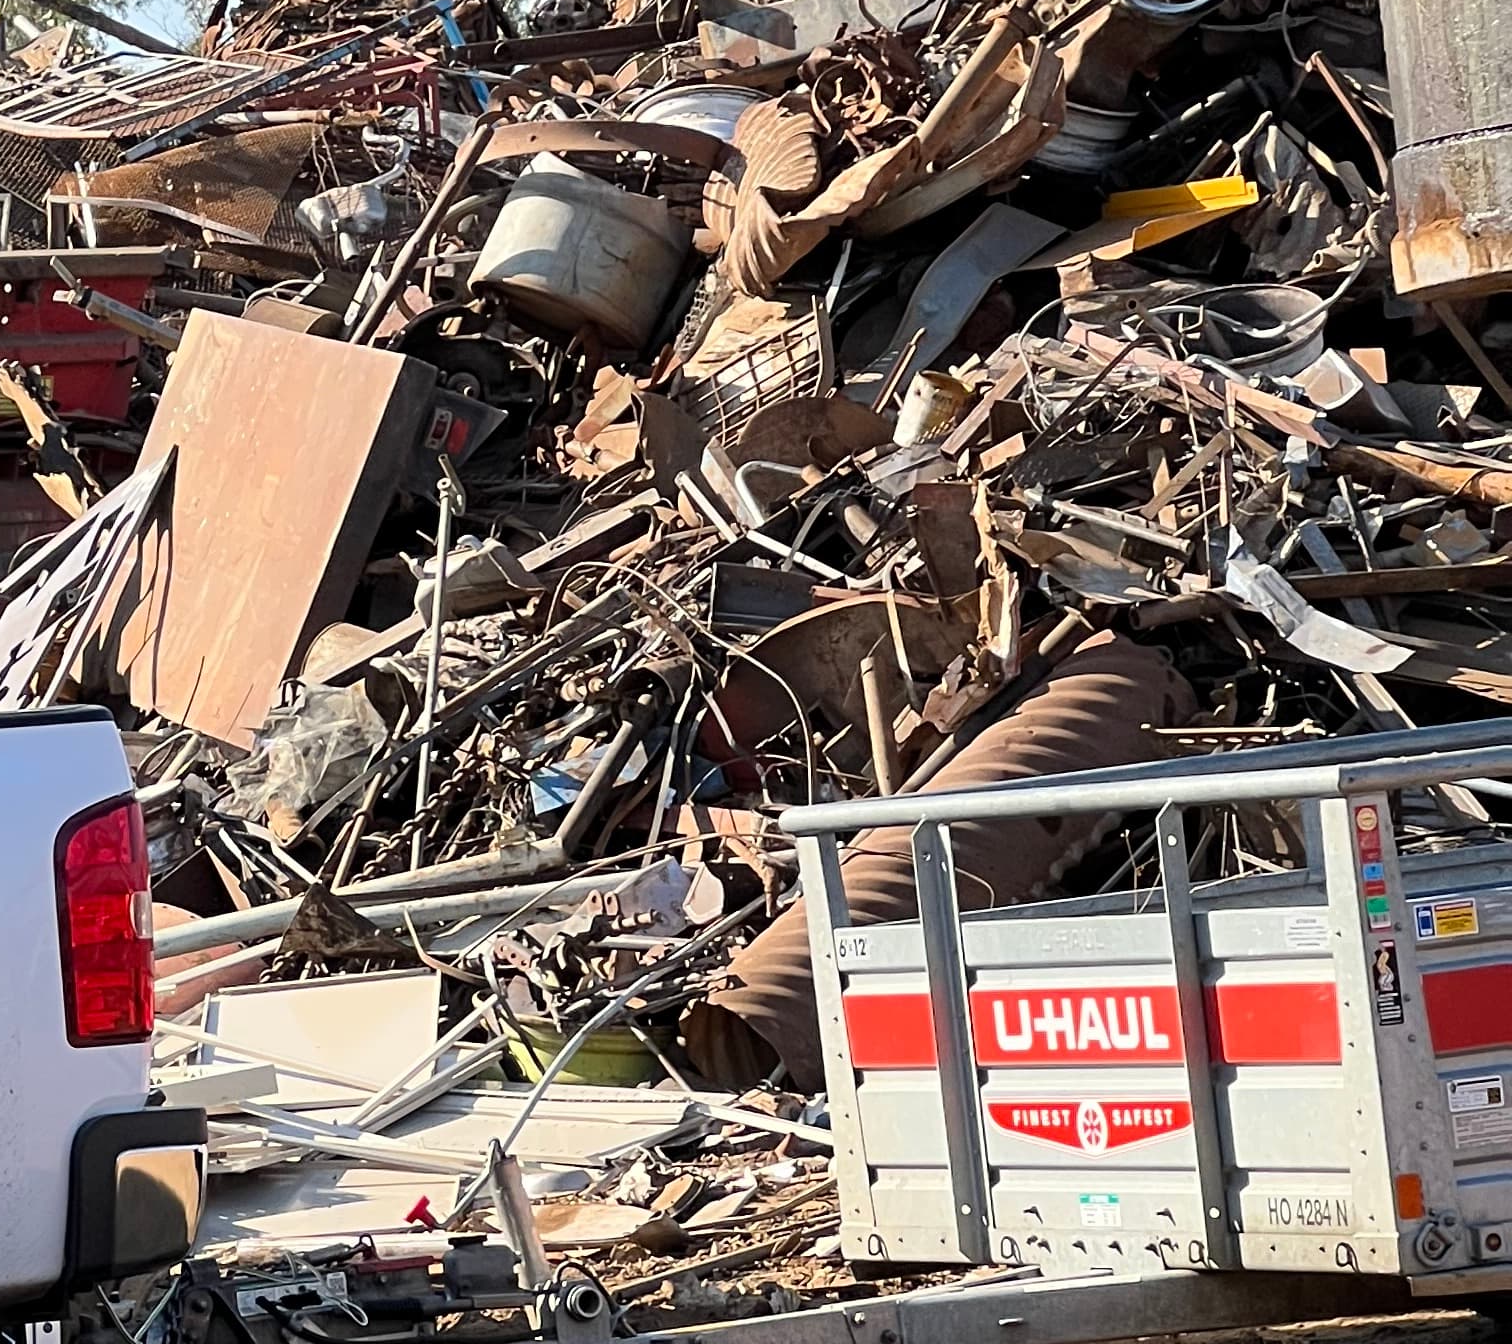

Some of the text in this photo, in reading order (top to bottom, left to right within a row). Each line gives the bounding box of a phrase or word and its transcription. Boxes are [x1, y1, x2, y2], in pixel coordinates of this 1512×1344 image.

[992, 996, 1170, 1051] U-HAUL
[1011, 1108, 1173, 1127] FINEST SAFEST
[1296, 1198, 1332, 1226] 4284
[1336, 1198, 1350, 1227] N
